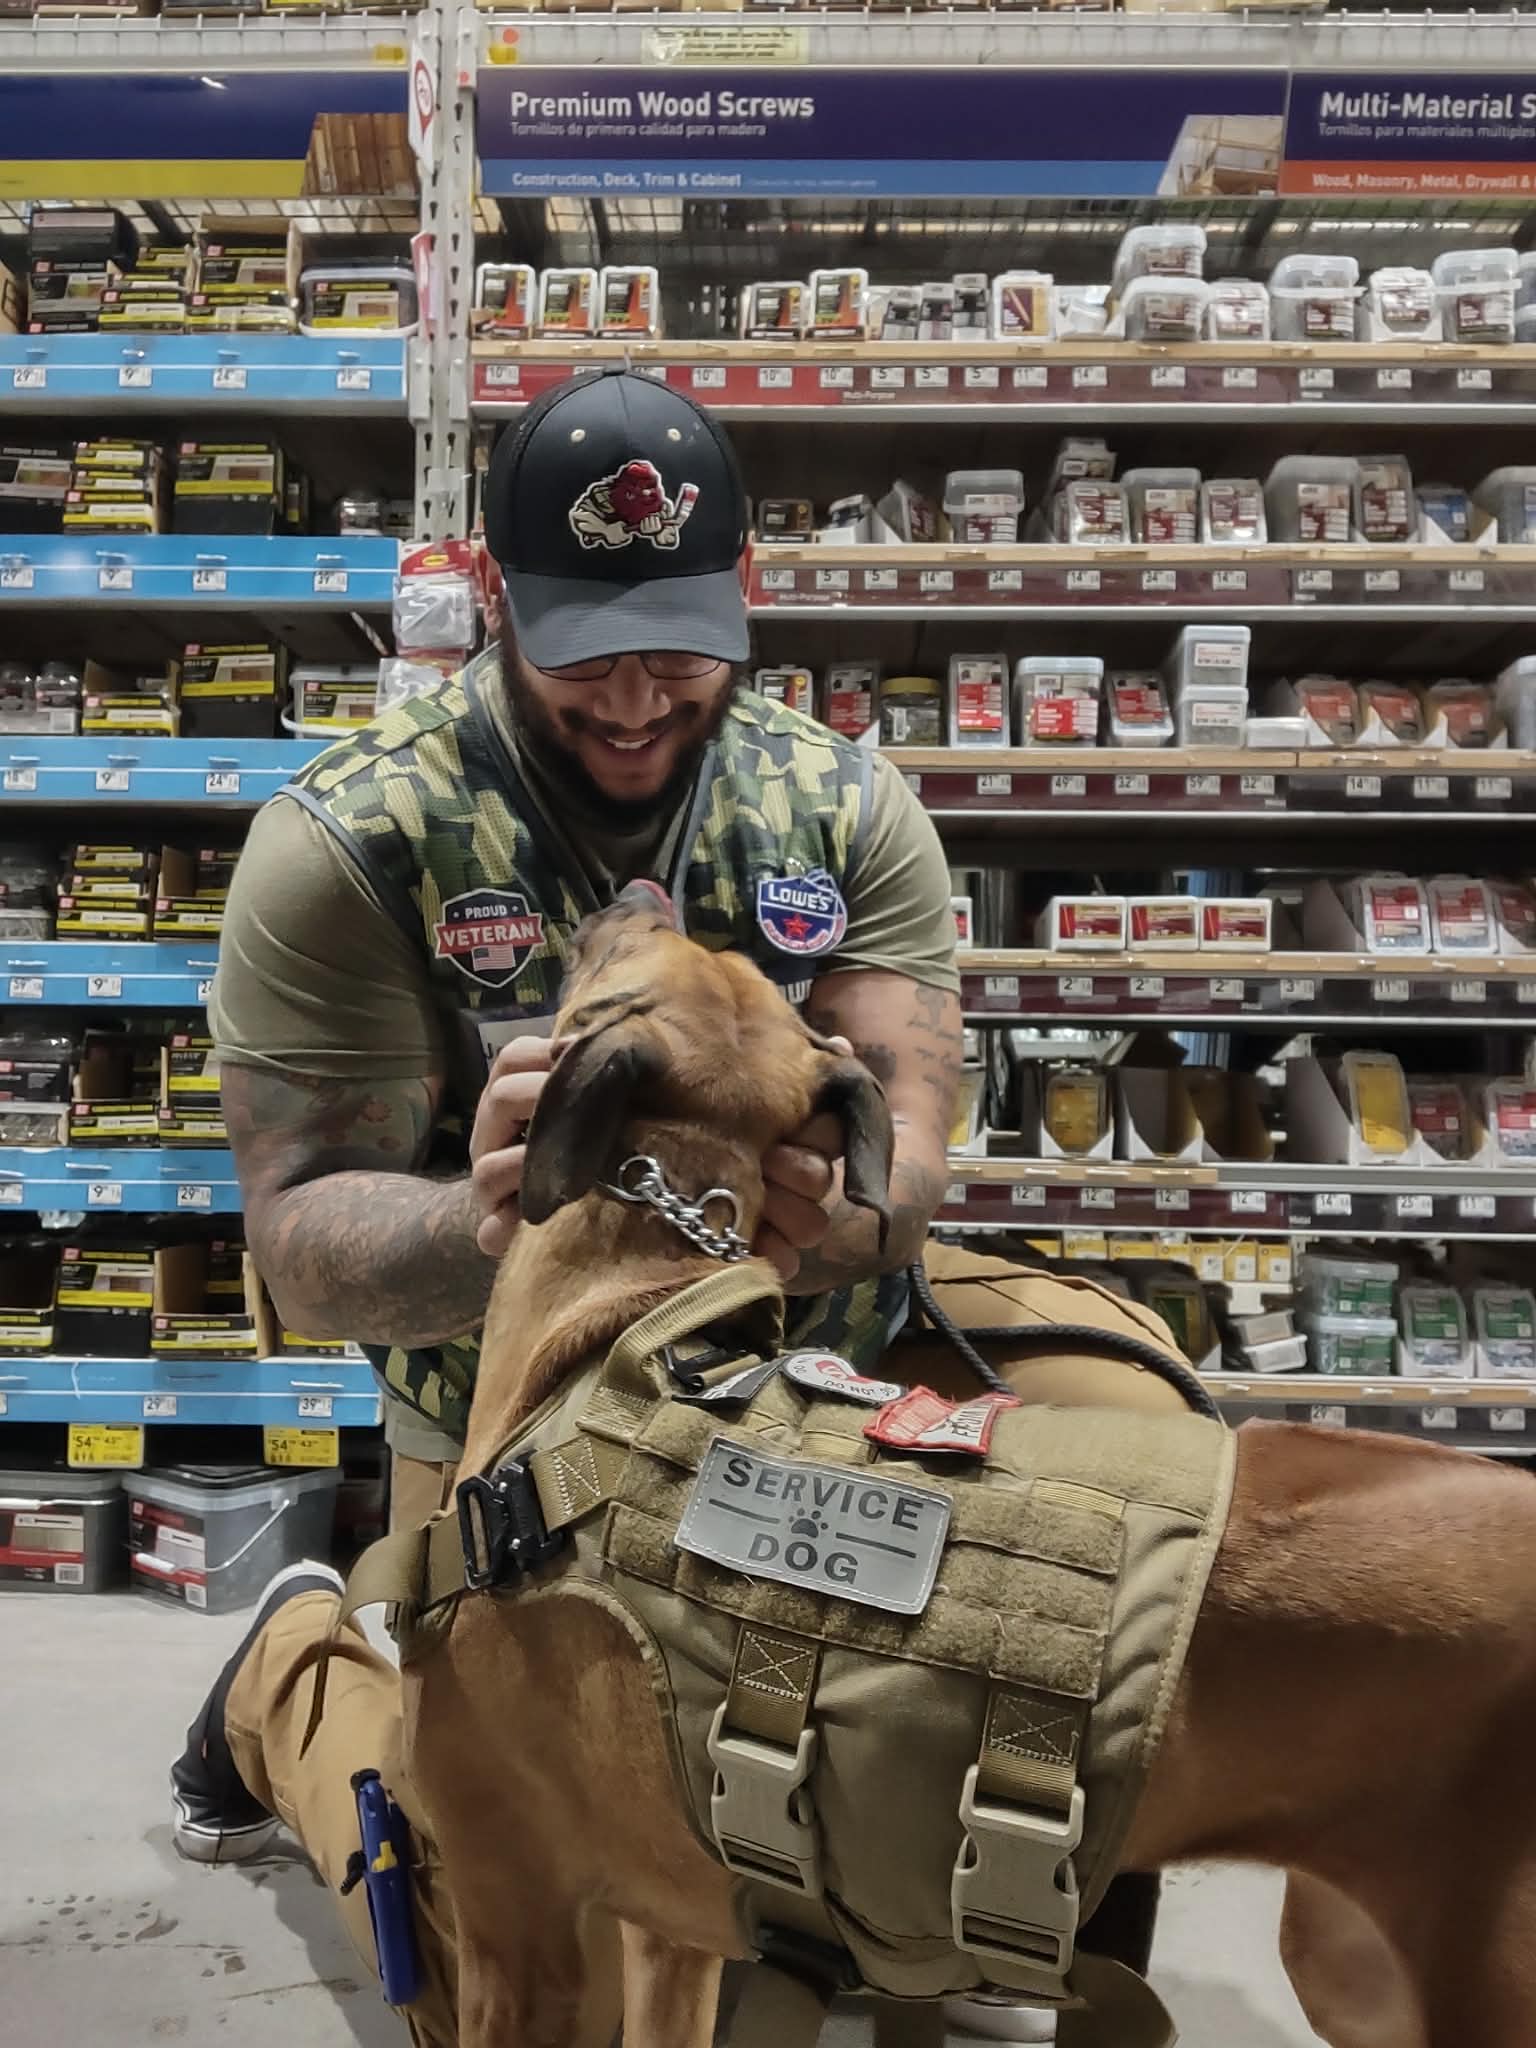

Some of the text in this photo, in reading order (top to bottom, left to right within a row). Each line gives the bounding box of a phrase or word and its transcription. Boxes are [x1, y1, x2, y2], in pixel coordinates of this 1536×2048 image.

[511, 91, 815, 117] Premium Wood Screws
[1319, 91, 1514, 119] Multi-Material
[511, 121, 767, 139] Tornillos de primera calidad para madera
[1319, 122, 1373, 137] Tornillos
[1375, 124, 1404, 140] para
[1407, 123, 1474, 138] materiales
[511, 171, 601, 188] Construction,
[603, 171, 641, 188] Deck,
[643, 171, 676, 187] Trim
[678, 171, 688, 187] &
[1312, 173, 1354, 189] Wood,
[1356, 174, 1418, 190] Masonry,
[1420, 174, 1463, 188] Metal,
[768, 883, 833, 911] LOWE'S
[464, 904, 508, 920] PROUD
[442, 921, 536, 947] VETERAN
[722, 1457, 924, 1532] SERVICE
[747, 1533, 859, 1585] DOG
